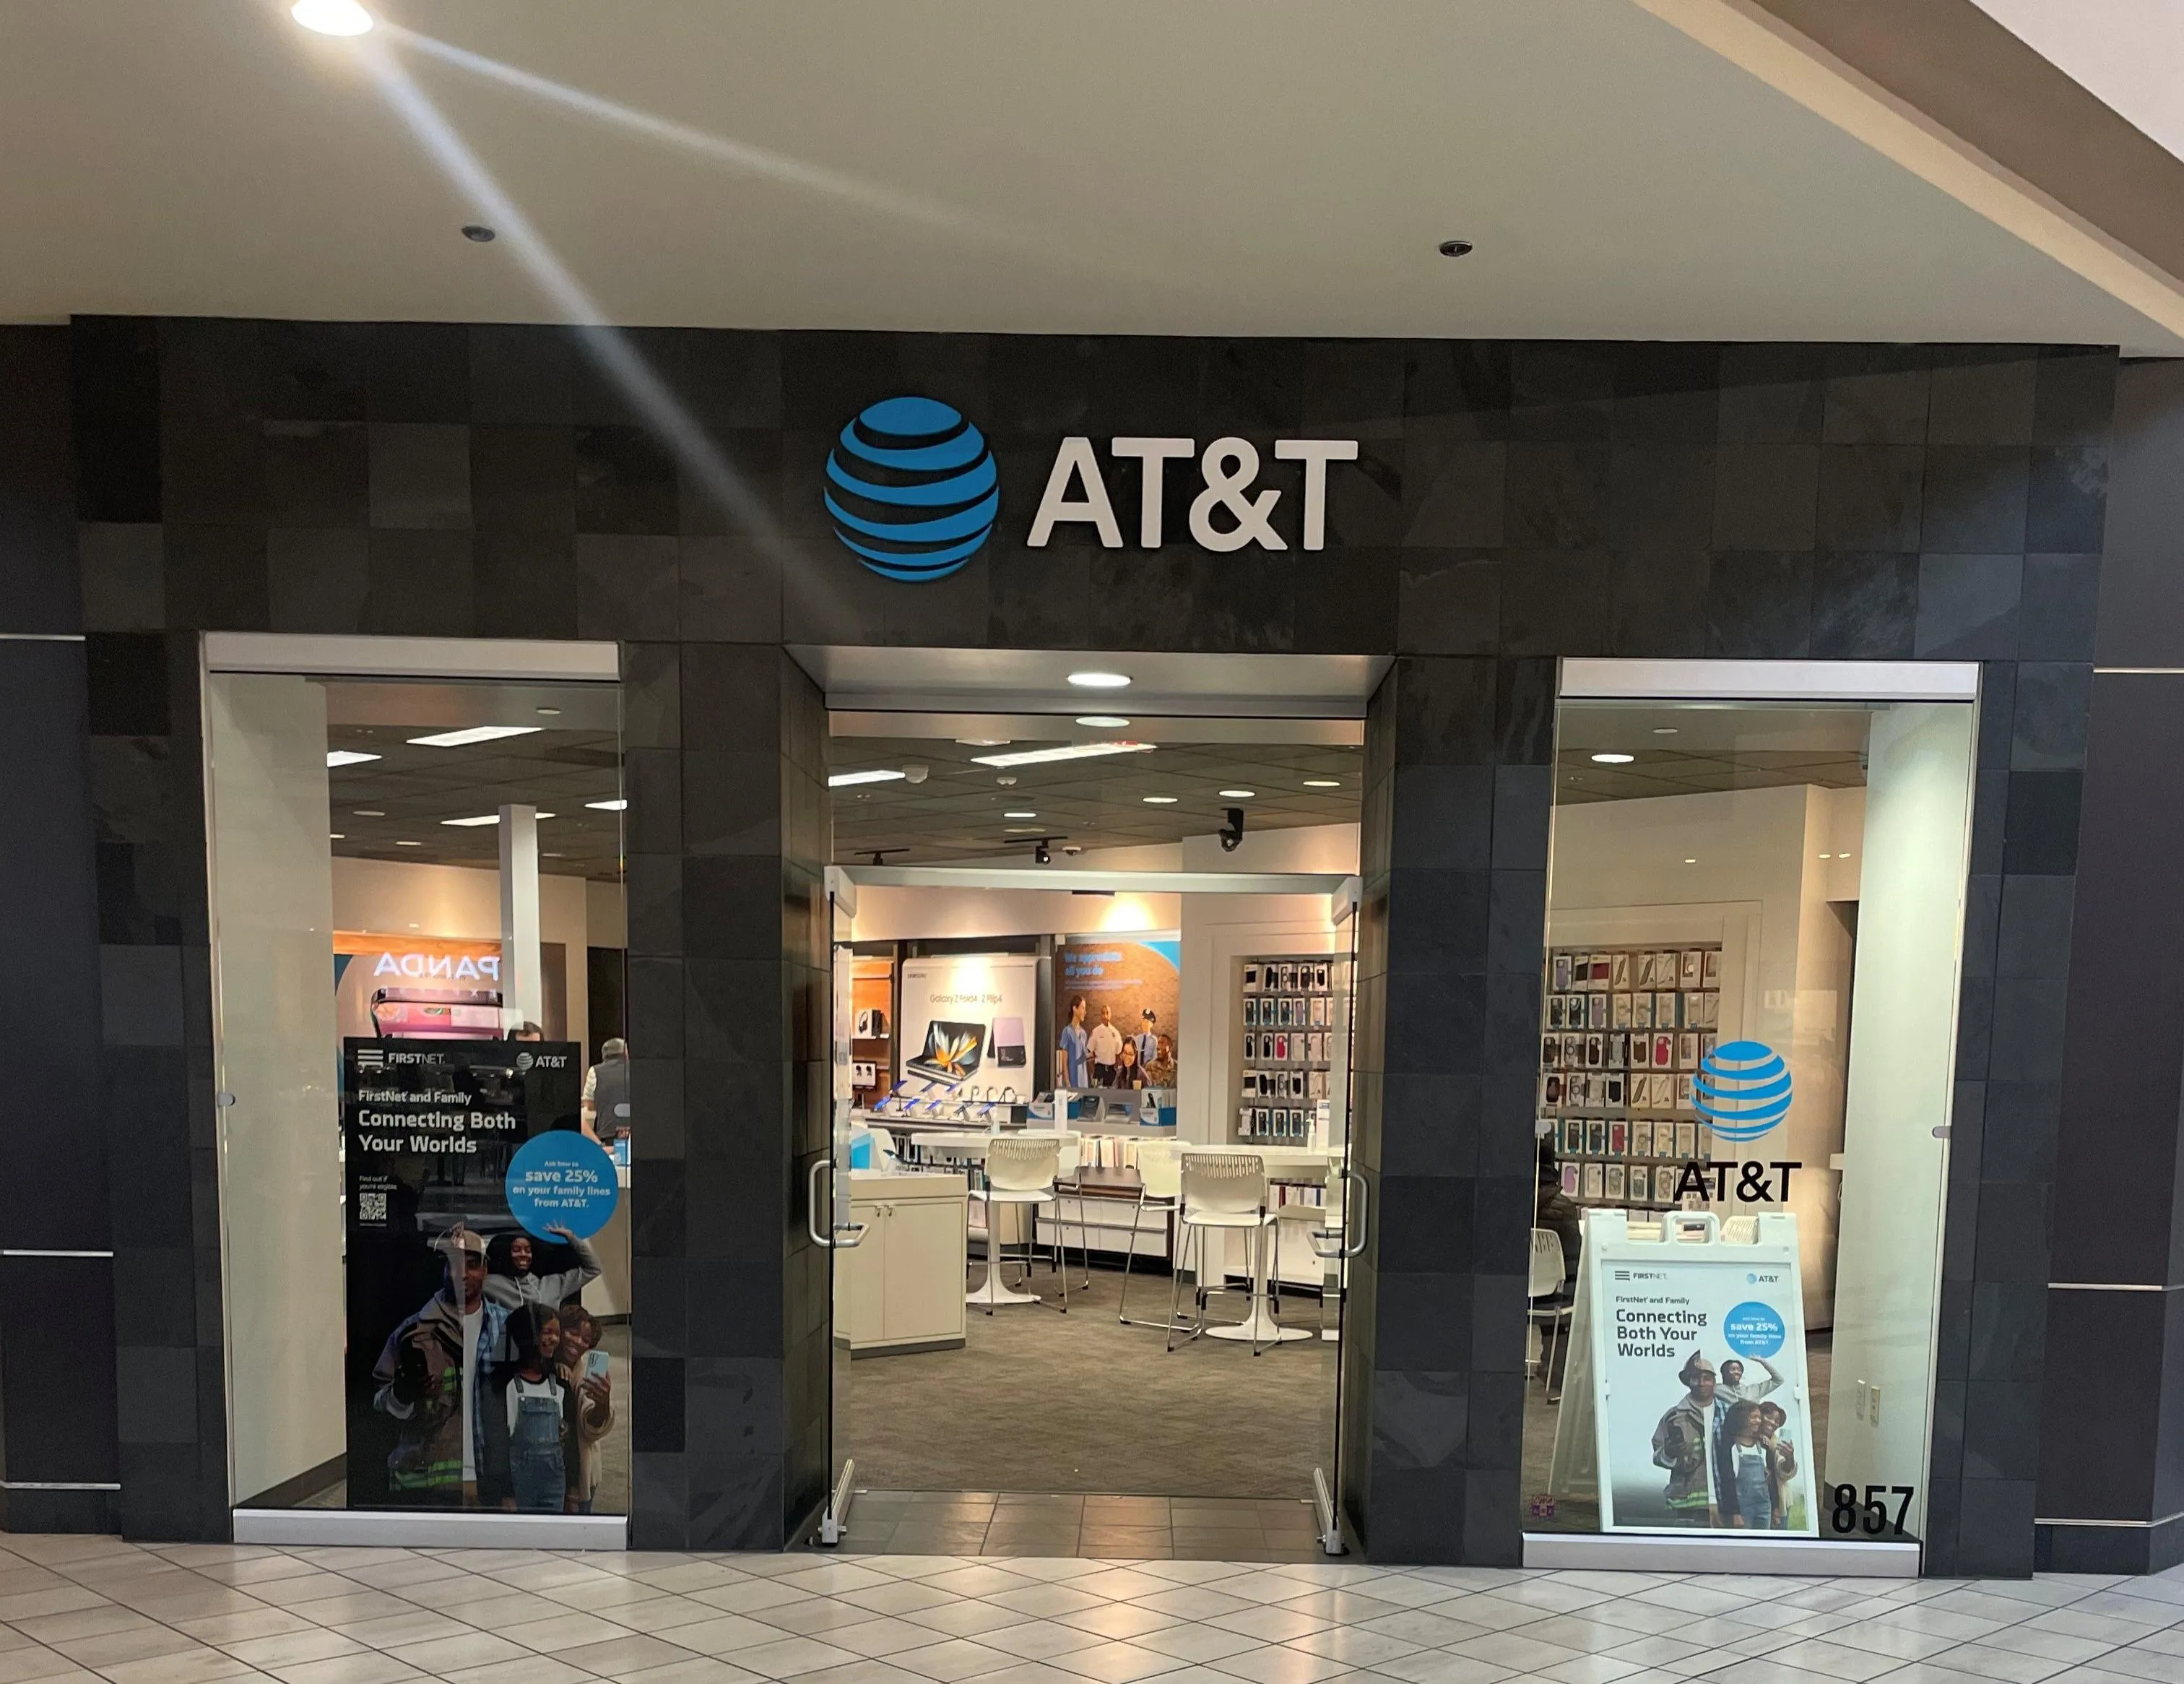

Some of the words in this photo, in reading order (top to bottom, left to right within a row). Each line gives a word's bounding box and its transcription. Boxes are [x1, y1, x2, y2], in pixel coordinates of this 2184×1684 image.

[1027, 436, 1358, 553] AT&T
[930, 993, 953, 1005] Galaxy
[535, 1055, 568, 1068] AT&T
[409, 1091, 432, 1103] and
[434, 1092, 472, 1105] Family
[358, 1110, 465, 1132] Connecting
[470, 1111, 516, 1130] Both
[358, 1134, 404, 1152] Your
[410, 1135, 477, 1154] Worlds
[525, 1171, 561, 1183] save
[564, 1170, 599, 1183] 25%
[1673, 1160, 1803, 1203] AT&T
[528, 1186, 551, 1196] your
[553, 1186, 584, 1197] family
[587, 1186, 610, 1196] lines
[534, 1198, 559, 1207] from
[1616, 1308, 1707, 1326] Connecting
[1617, 1326, 1656, 1340] Both
[1660, 1326, 1697, 1340] Your
[1756, 1322, 1778, 1331] 25%
[1618, 1343, 1676, 1357] Worlds
[1832, 1483, 1914, 1534] 857
